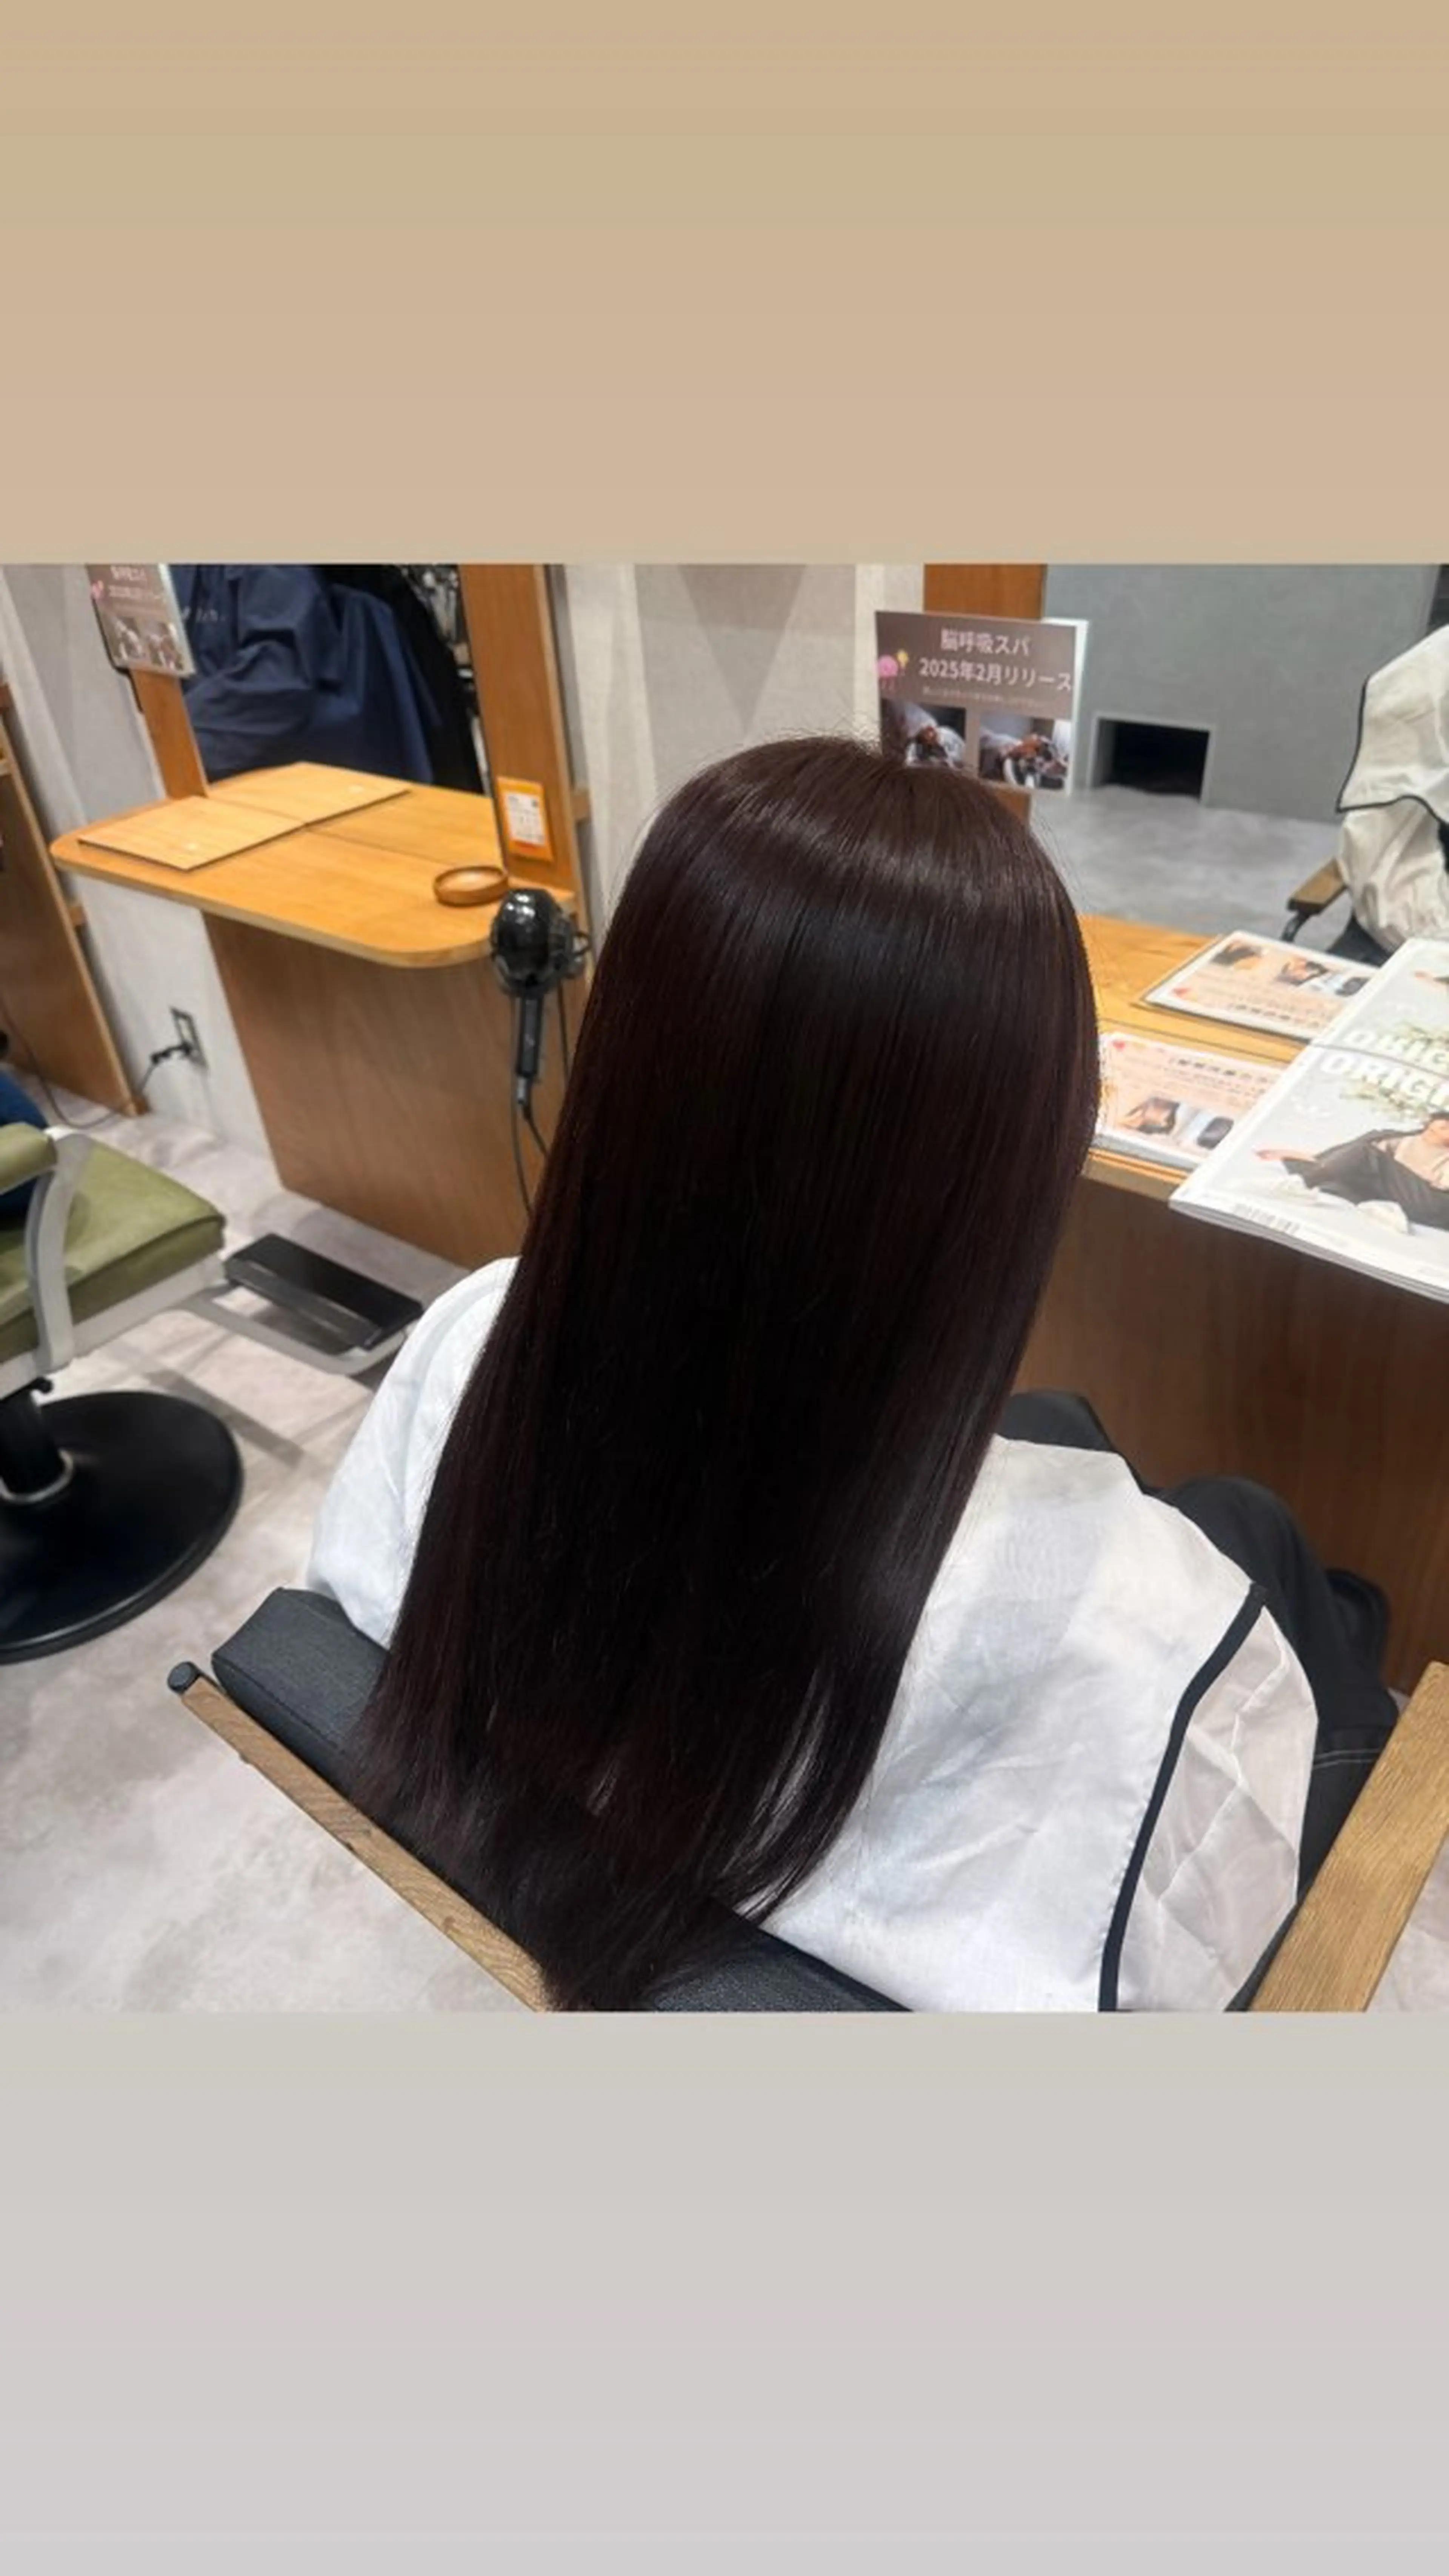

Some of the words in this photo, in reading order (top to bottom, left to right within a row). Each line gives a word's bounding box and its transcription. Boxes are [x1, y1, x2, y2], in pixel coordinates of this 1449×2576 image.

[919, 658, 1071, 692] 2025年2月リリース
